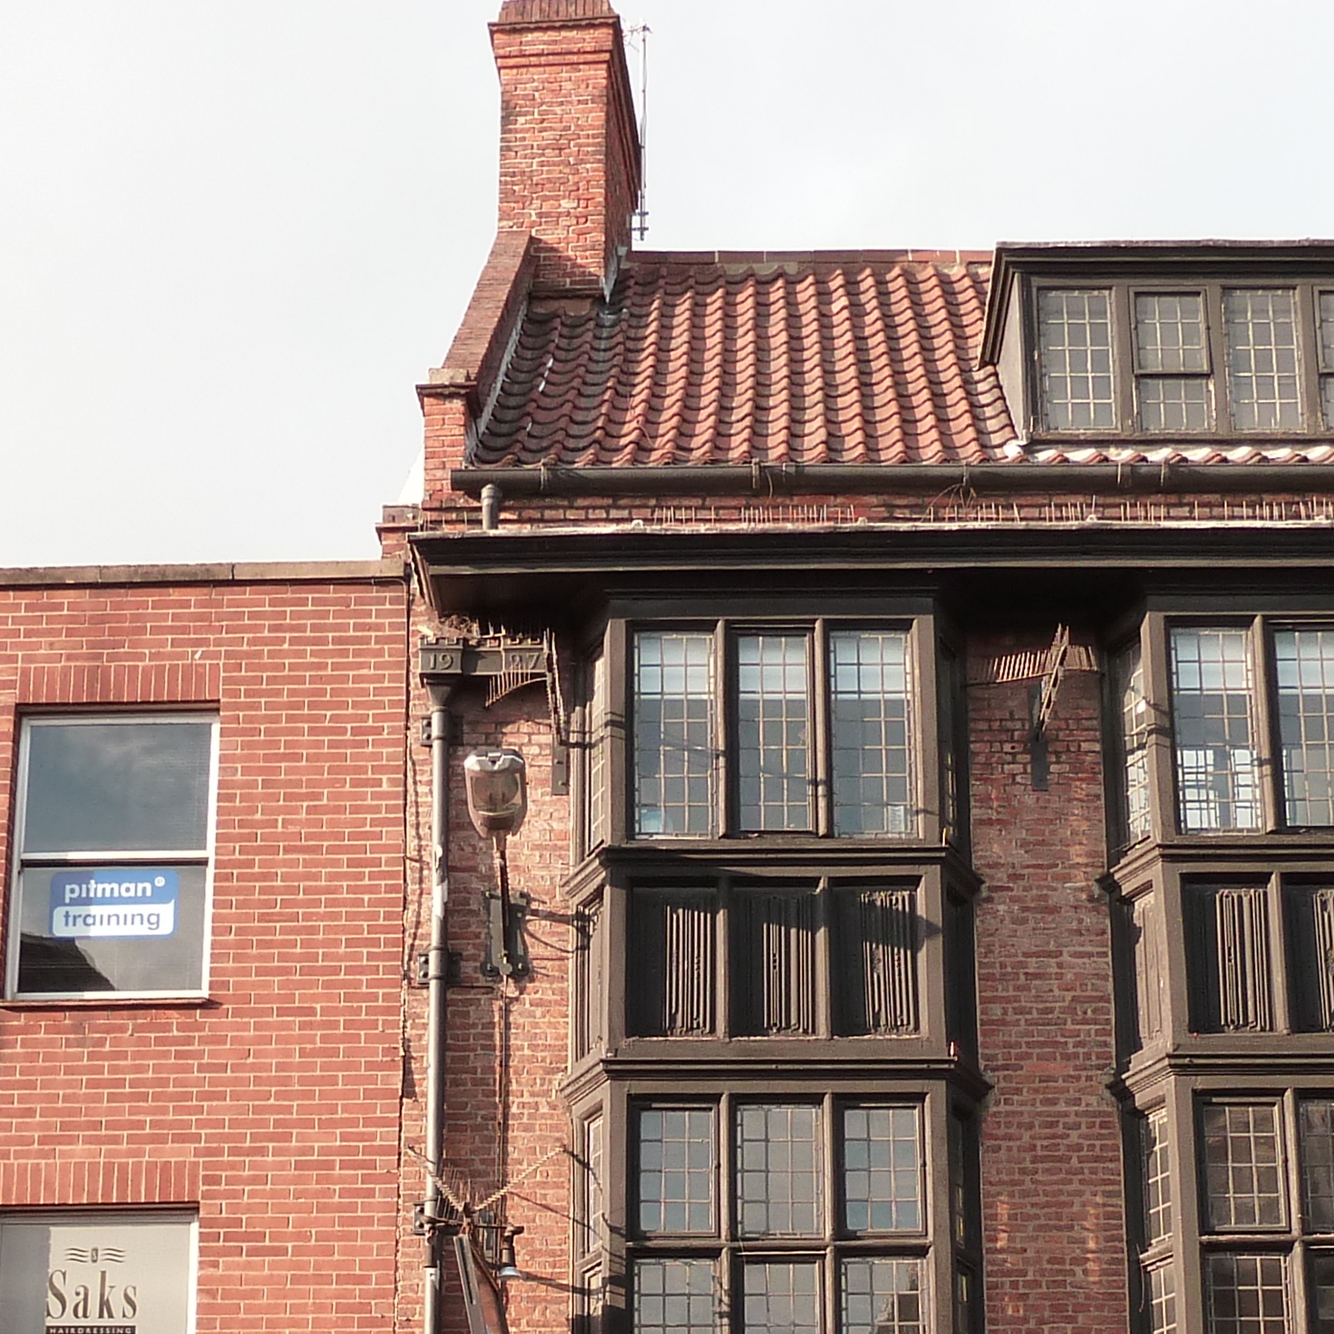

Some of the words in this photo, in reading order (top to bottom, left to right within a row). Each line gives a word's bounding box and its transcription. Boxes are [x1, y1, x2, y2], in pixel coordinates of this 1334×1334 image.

[63, 910, 161, 931] training
[45, 1269, 137, 1320] Saks
[48, 1326, 132, 1334] HAIRDRESSING
